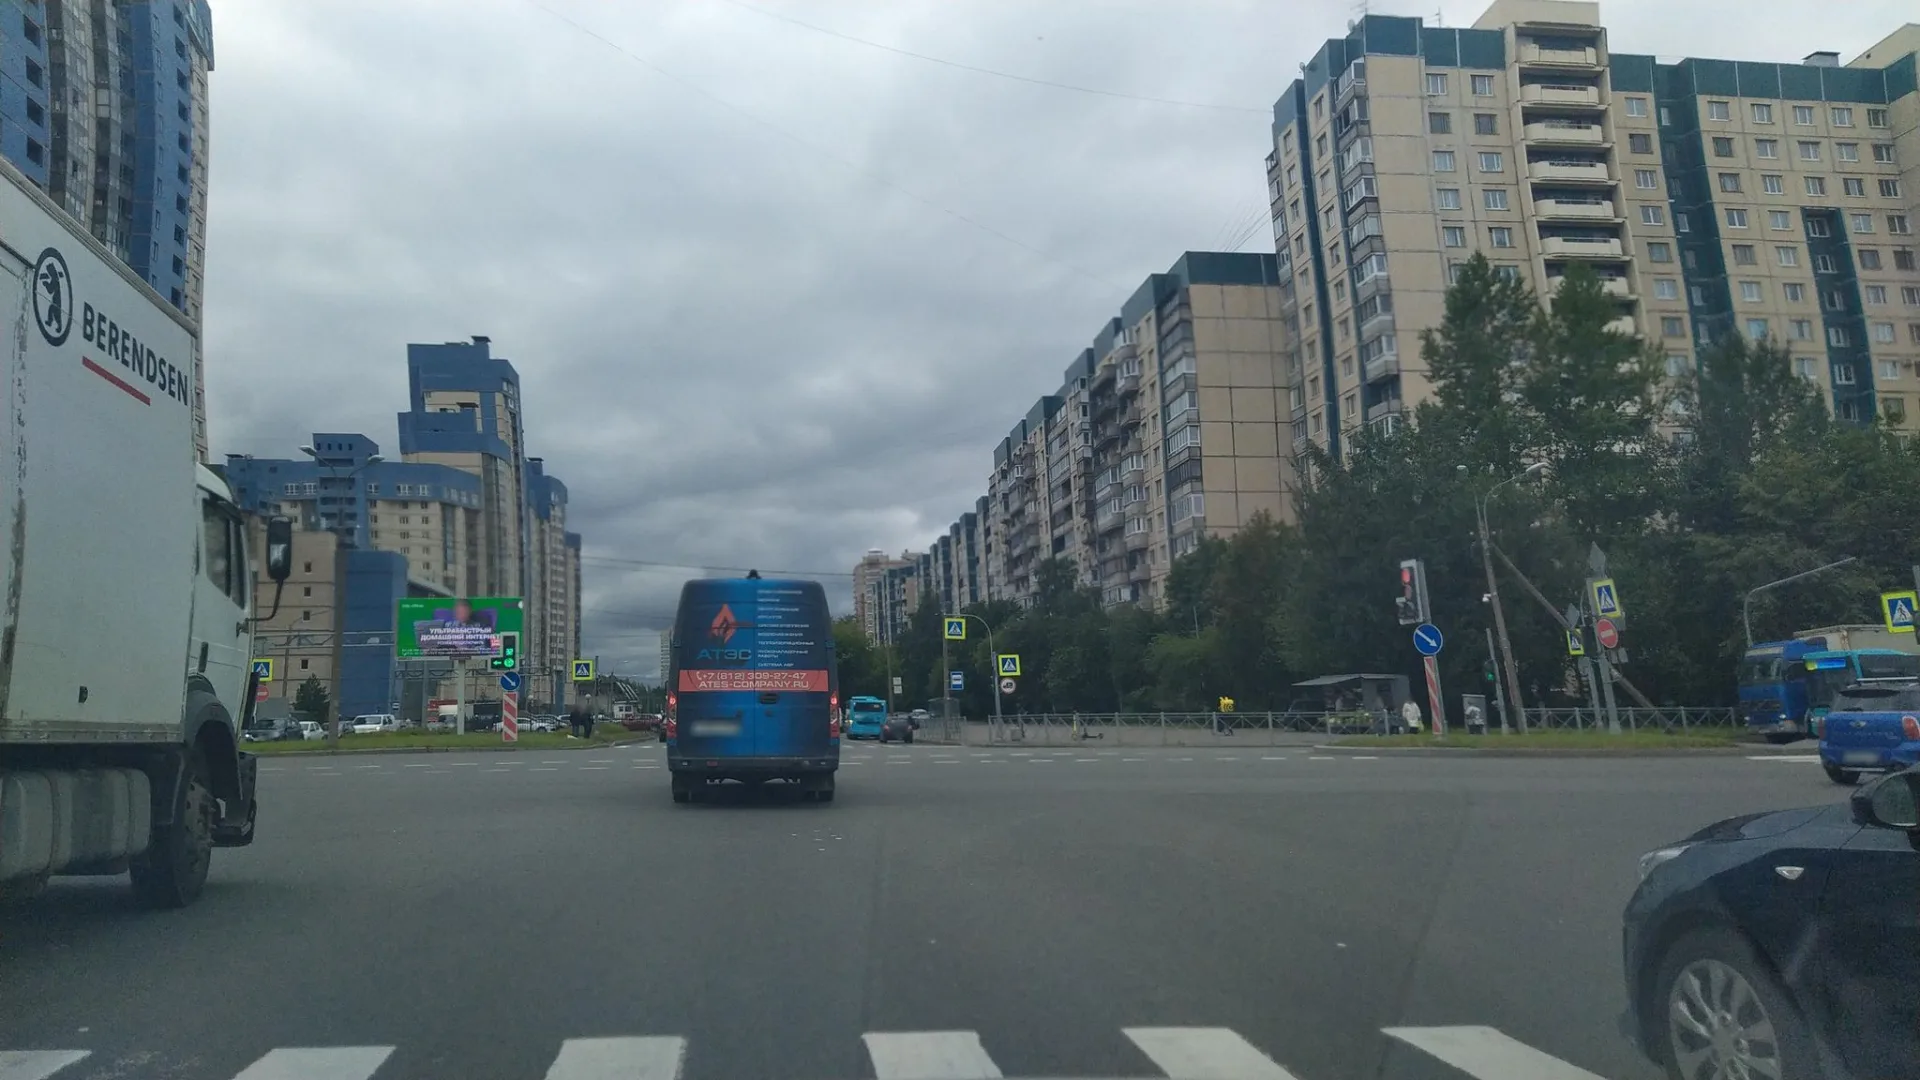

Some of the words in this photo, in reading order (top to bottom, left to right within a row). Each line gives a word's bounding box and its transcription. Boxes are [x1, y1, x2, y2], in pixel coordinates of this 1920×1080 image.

[82, 301, 188, 406] BERENDSEN
[429, 627, 492, 635] УЛЬТРАБЫСТРЫЙ
[421, 633, 465, 641] ДОМАШНИЙ
[465, 633, 501, 641] ИНТЕРНЕТ
[696, 649, 752, 660] АТЭС
[703, 672, 715, 680] +7
[717, 672, 745, 681] (812)
[747, 672, 807, 680] 309-27-47
